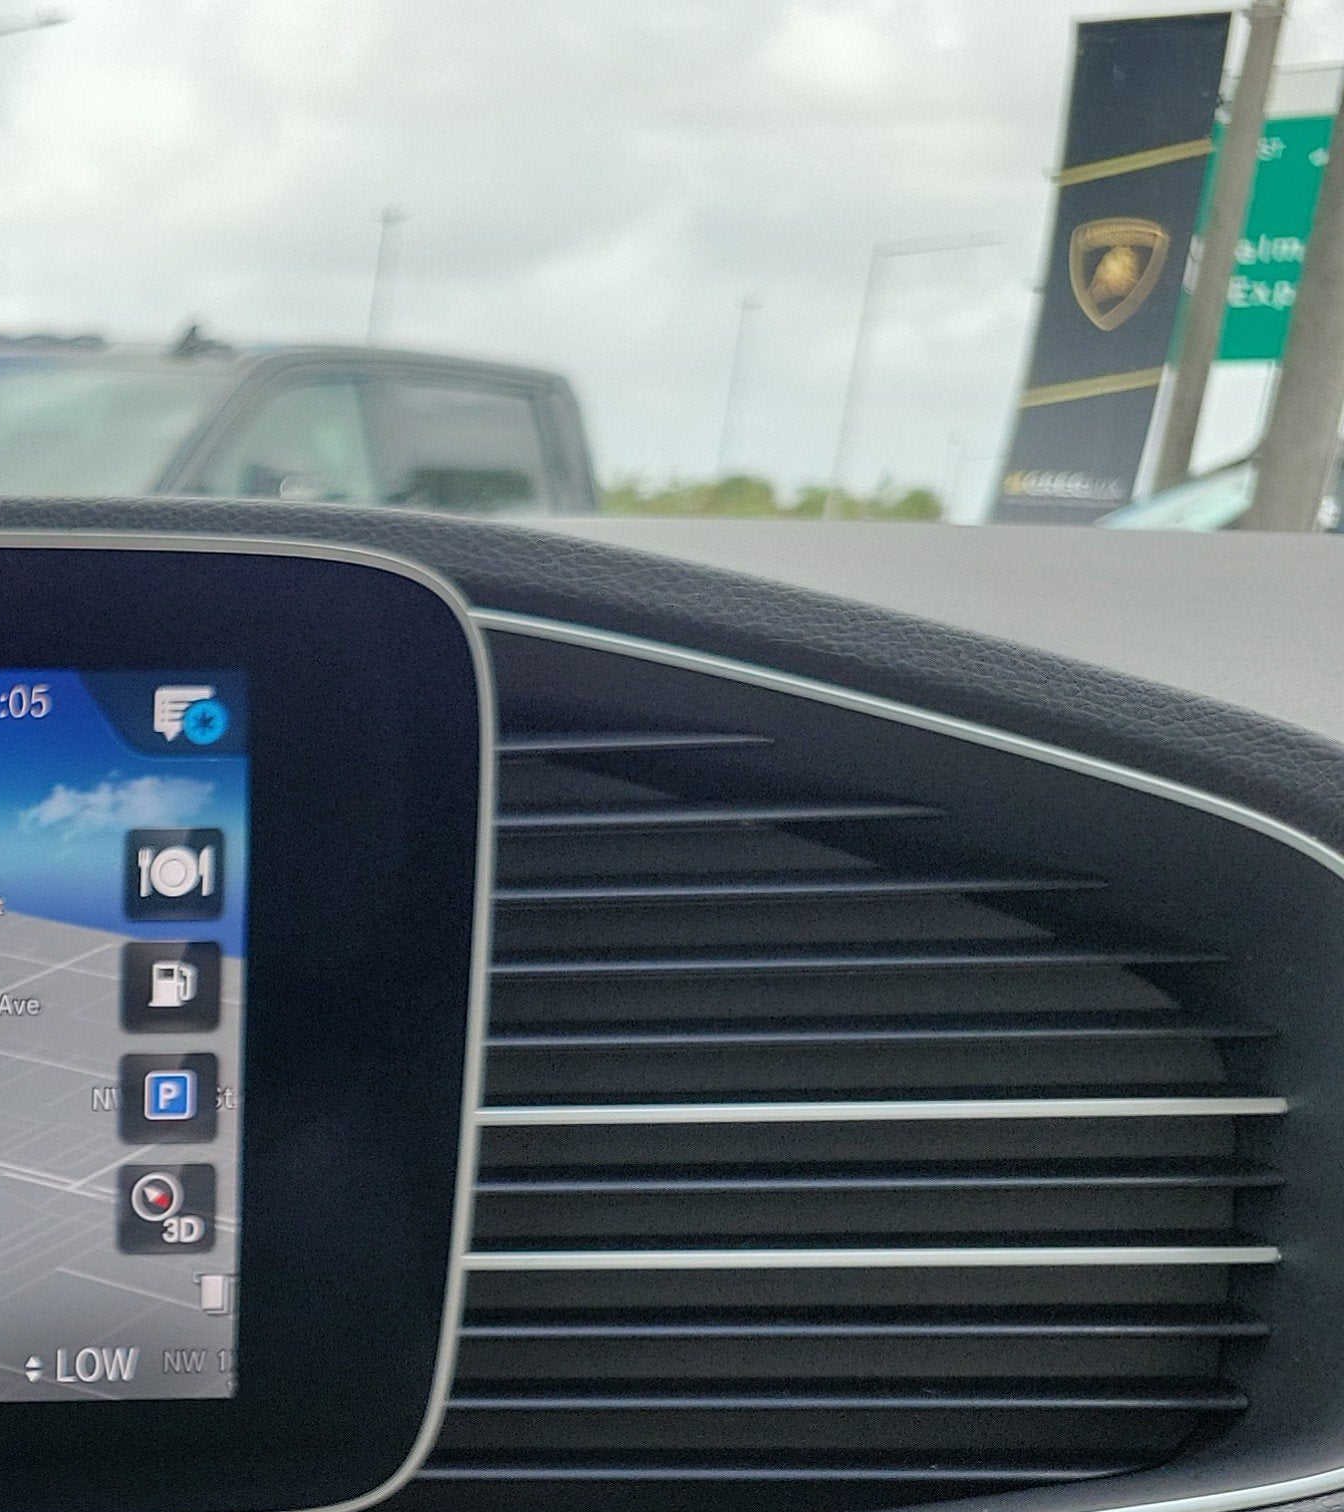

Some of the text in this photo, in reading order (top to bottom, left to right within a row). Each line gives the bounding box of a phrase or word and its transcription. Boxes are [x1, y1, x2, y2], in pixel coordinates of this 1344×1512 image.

[158, 1082, 180, 1110] P
[162, 1216, 205, 1243] 3D
[56, 1346, 139, 1383] LOW
[163, 1350, 207, 1374] NW
